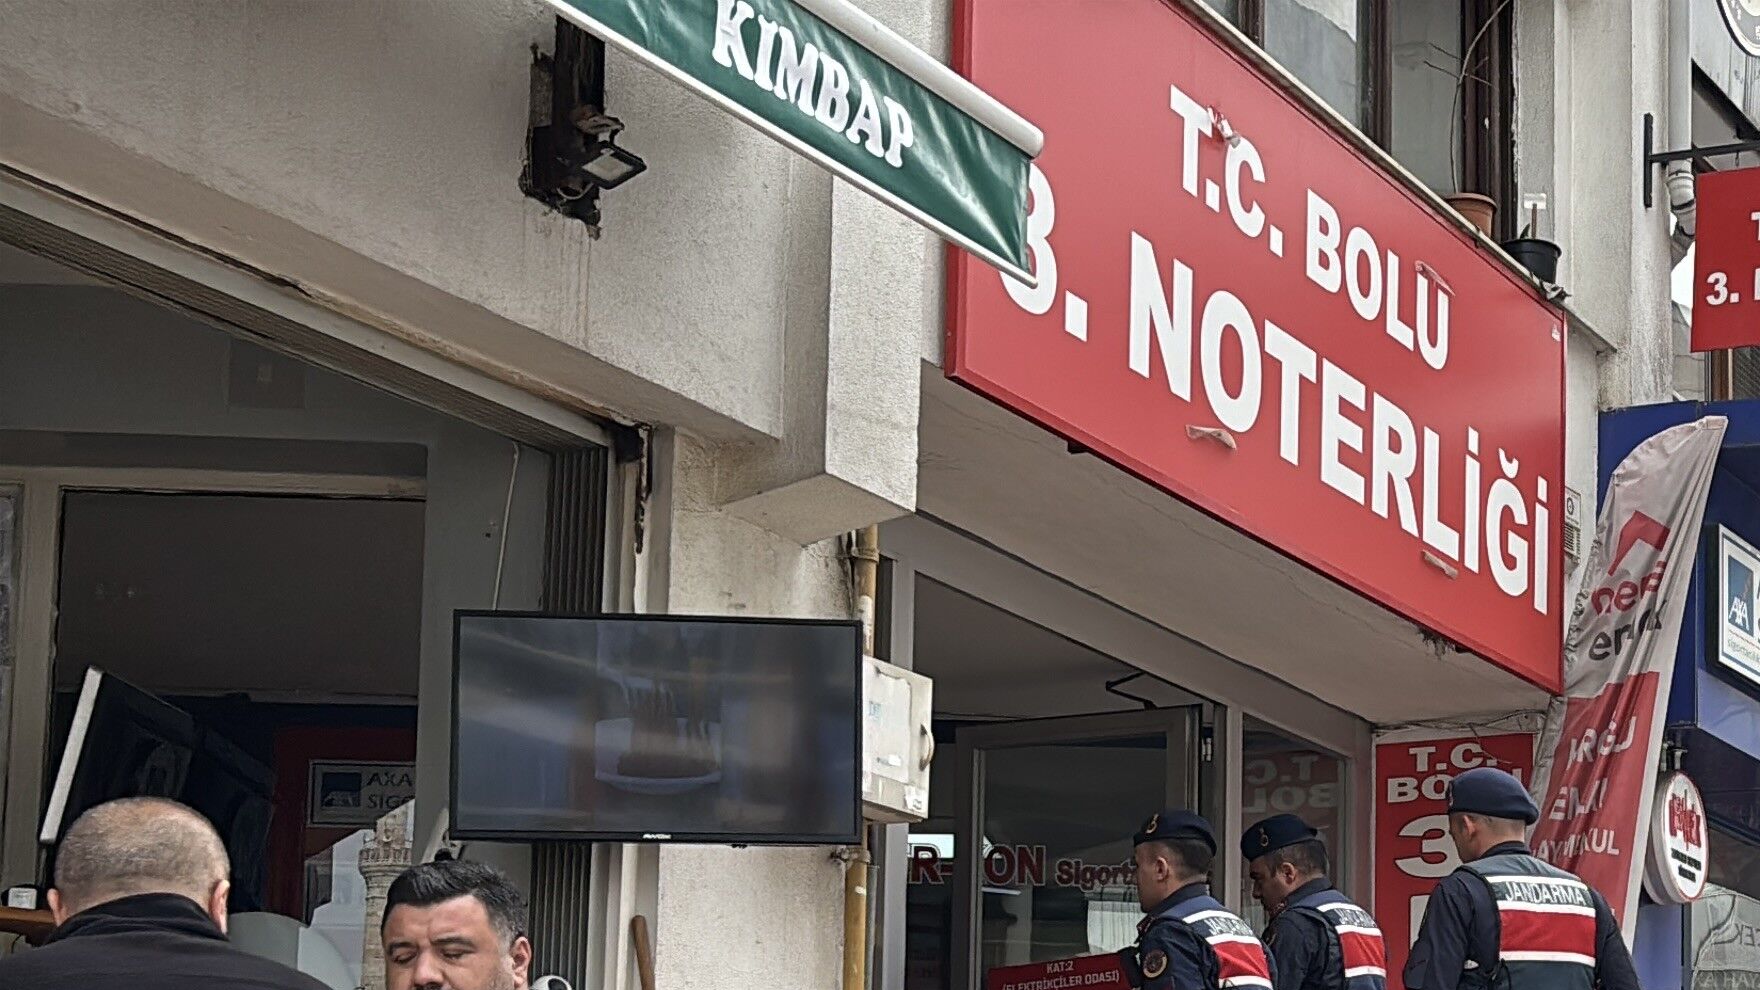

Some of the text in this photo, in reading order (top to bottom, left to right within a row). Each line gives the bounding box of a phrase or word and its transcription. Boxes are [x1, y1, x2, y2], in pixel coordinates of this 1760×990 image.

[711, 0, 914, 168] KIMBAP
[1170, 83, 1284, 257] T.C.
[1705, 272, 1740, 306] 3.
[1128, 230, 1548, 616] NOTERLİĞİ
[1409, 742, 1498, 772] T.C.
[1505, 881, 1587, 907] JANDARMA
[1046, 960, 1074, 974] KAT:2
